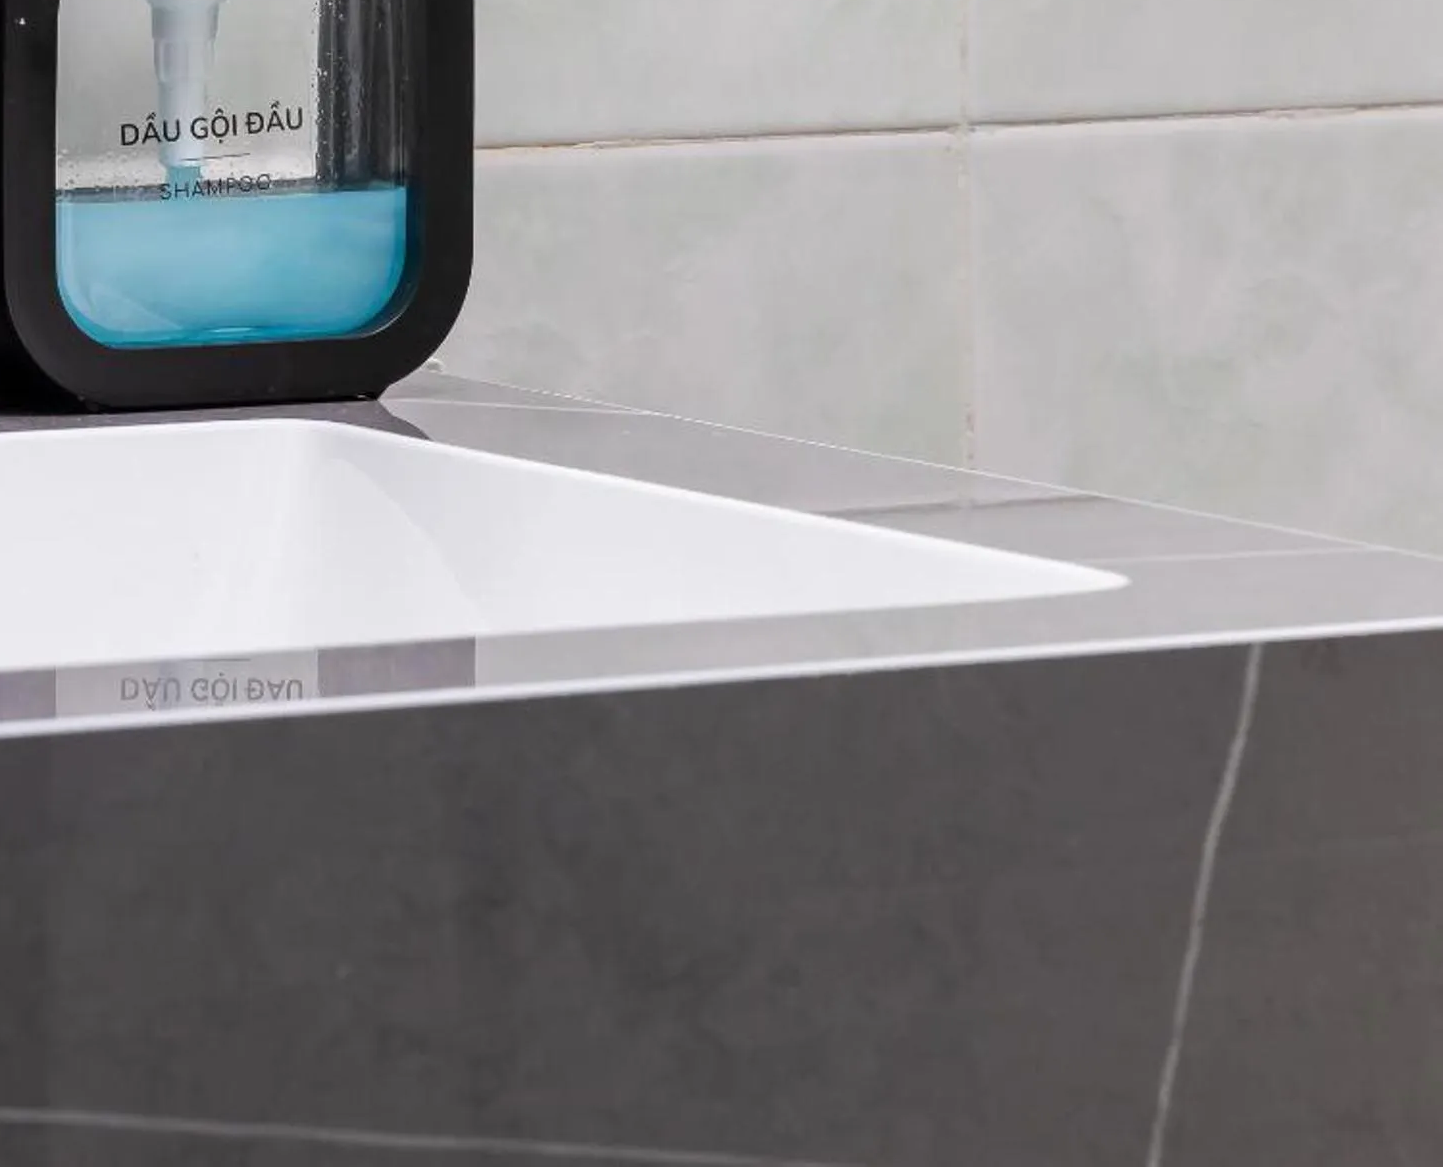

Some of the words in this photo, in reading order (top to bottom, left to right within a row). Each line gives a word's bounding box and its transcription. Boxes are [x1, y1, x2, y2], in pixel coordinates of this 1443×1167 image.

[120, 112, 180, 146] DẦU
[190, 108, 238, 144] GỘI
[246, 100, 303, 134] ĐẦU
[160, 173, 272, 200] SHAMPOO
